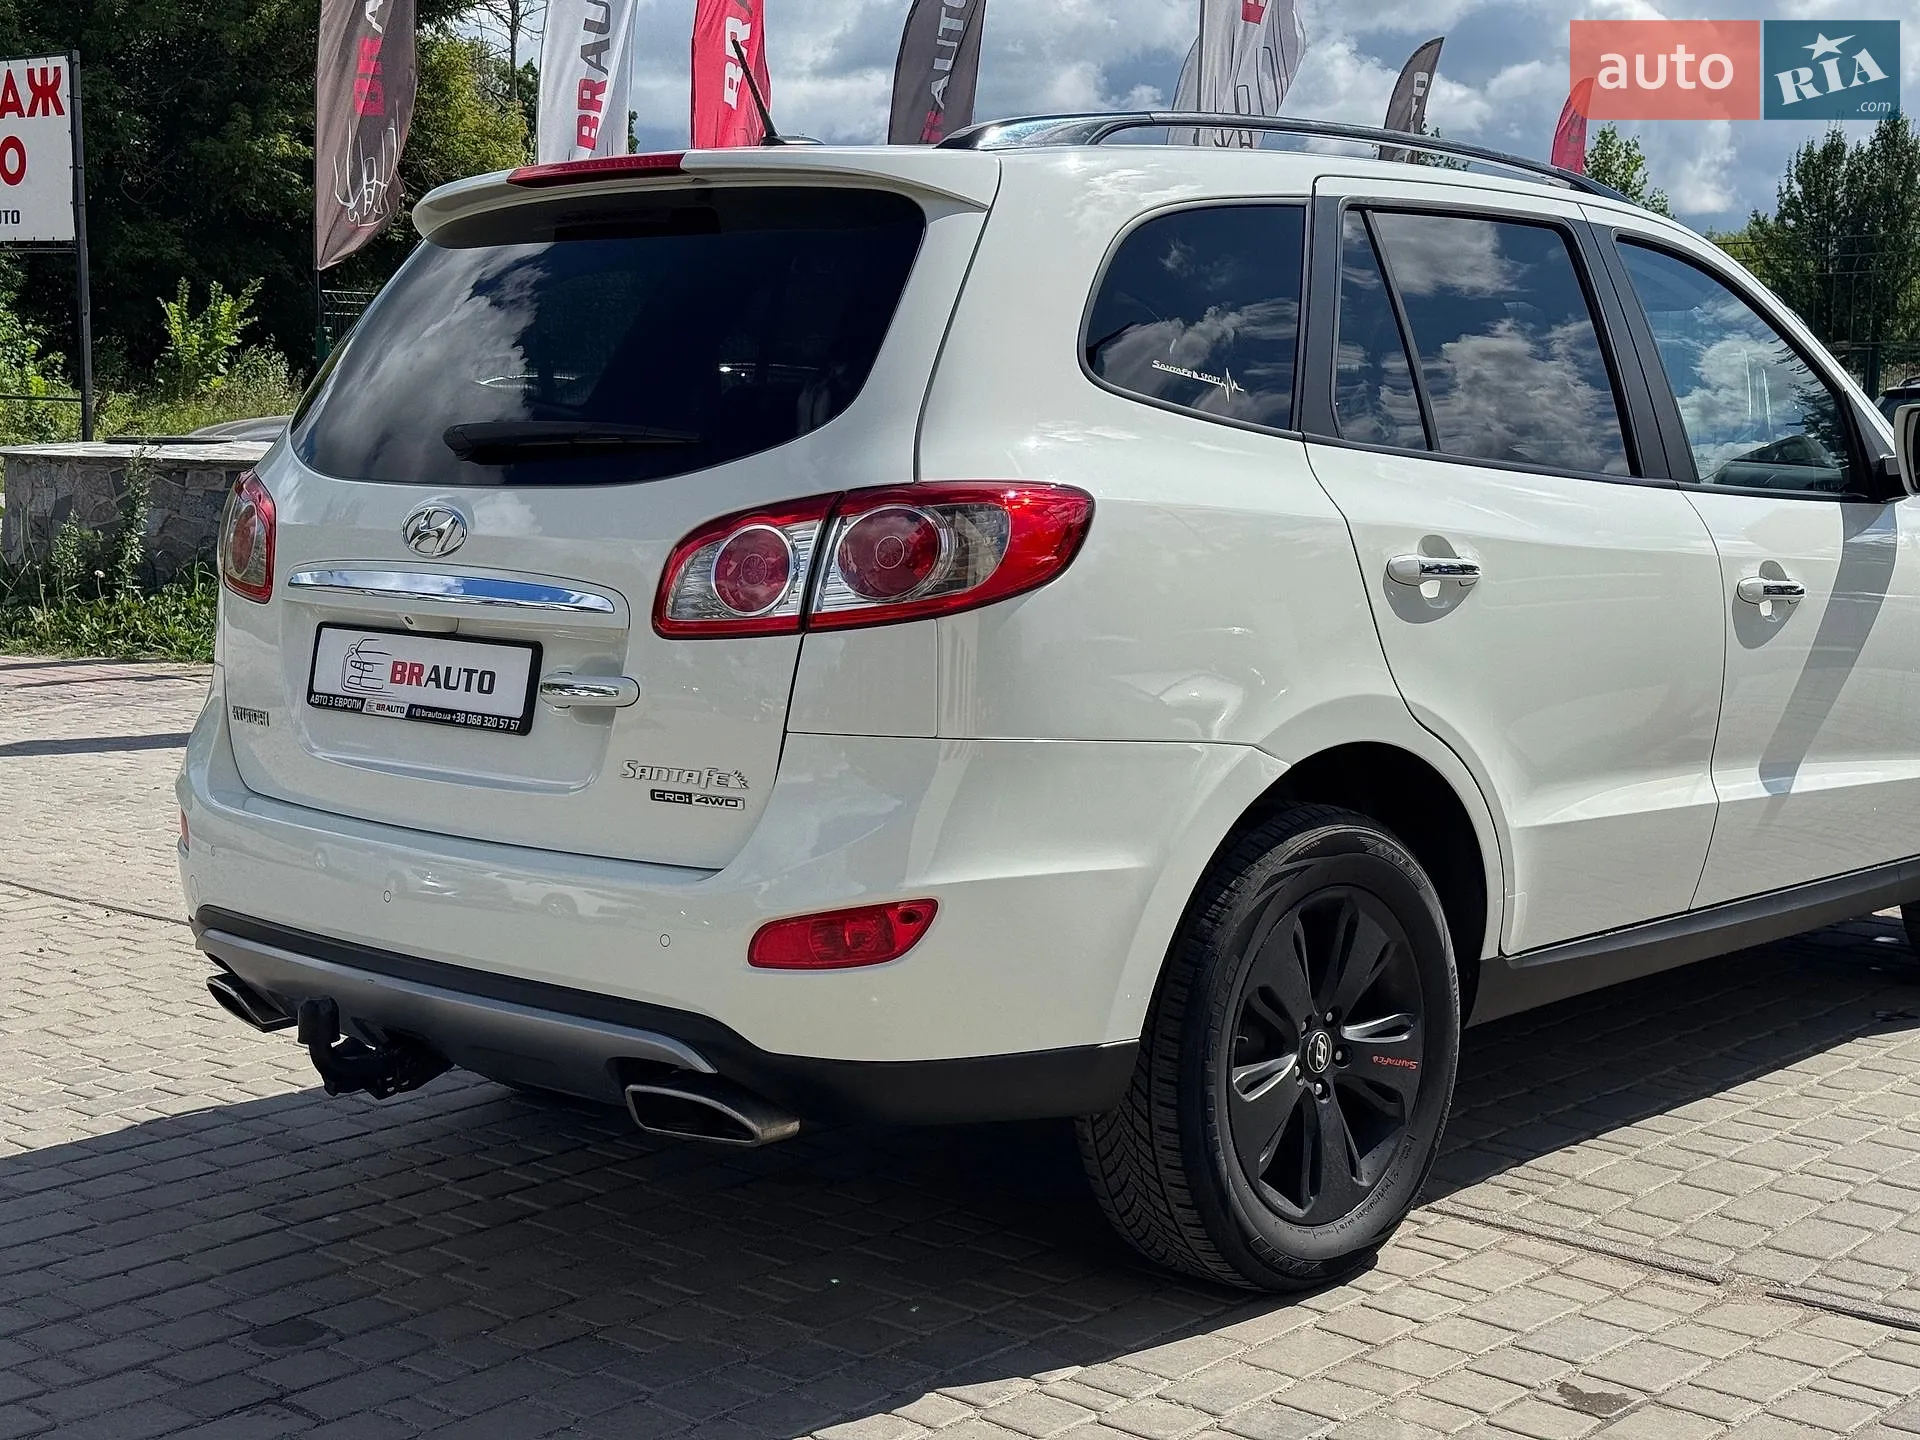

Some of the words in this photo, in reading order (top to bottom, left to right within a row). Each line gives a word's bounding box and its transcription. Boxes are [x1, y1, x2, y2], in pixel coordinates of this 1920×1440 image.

[723, 0, 755, 111] BR
[577, 0, 611, 151] BRAU
[0, 66, 65, 119] АЖ
[1200, 372, 1221, 384] SPORT
[389, 660, 496, 695] BRAUTO
[310, 694, 328, 706] АВТО
[375, 703, 405, 715] BRAUTO
[452, 712, 466, 724] +38
[467, 713, 482, 726] 068
[483, 716, 498, 728] 320
[499, 718, 509, 730] 57
[510, 720, 520, 731] 57
[694, 793, 739, 808] 4WD
